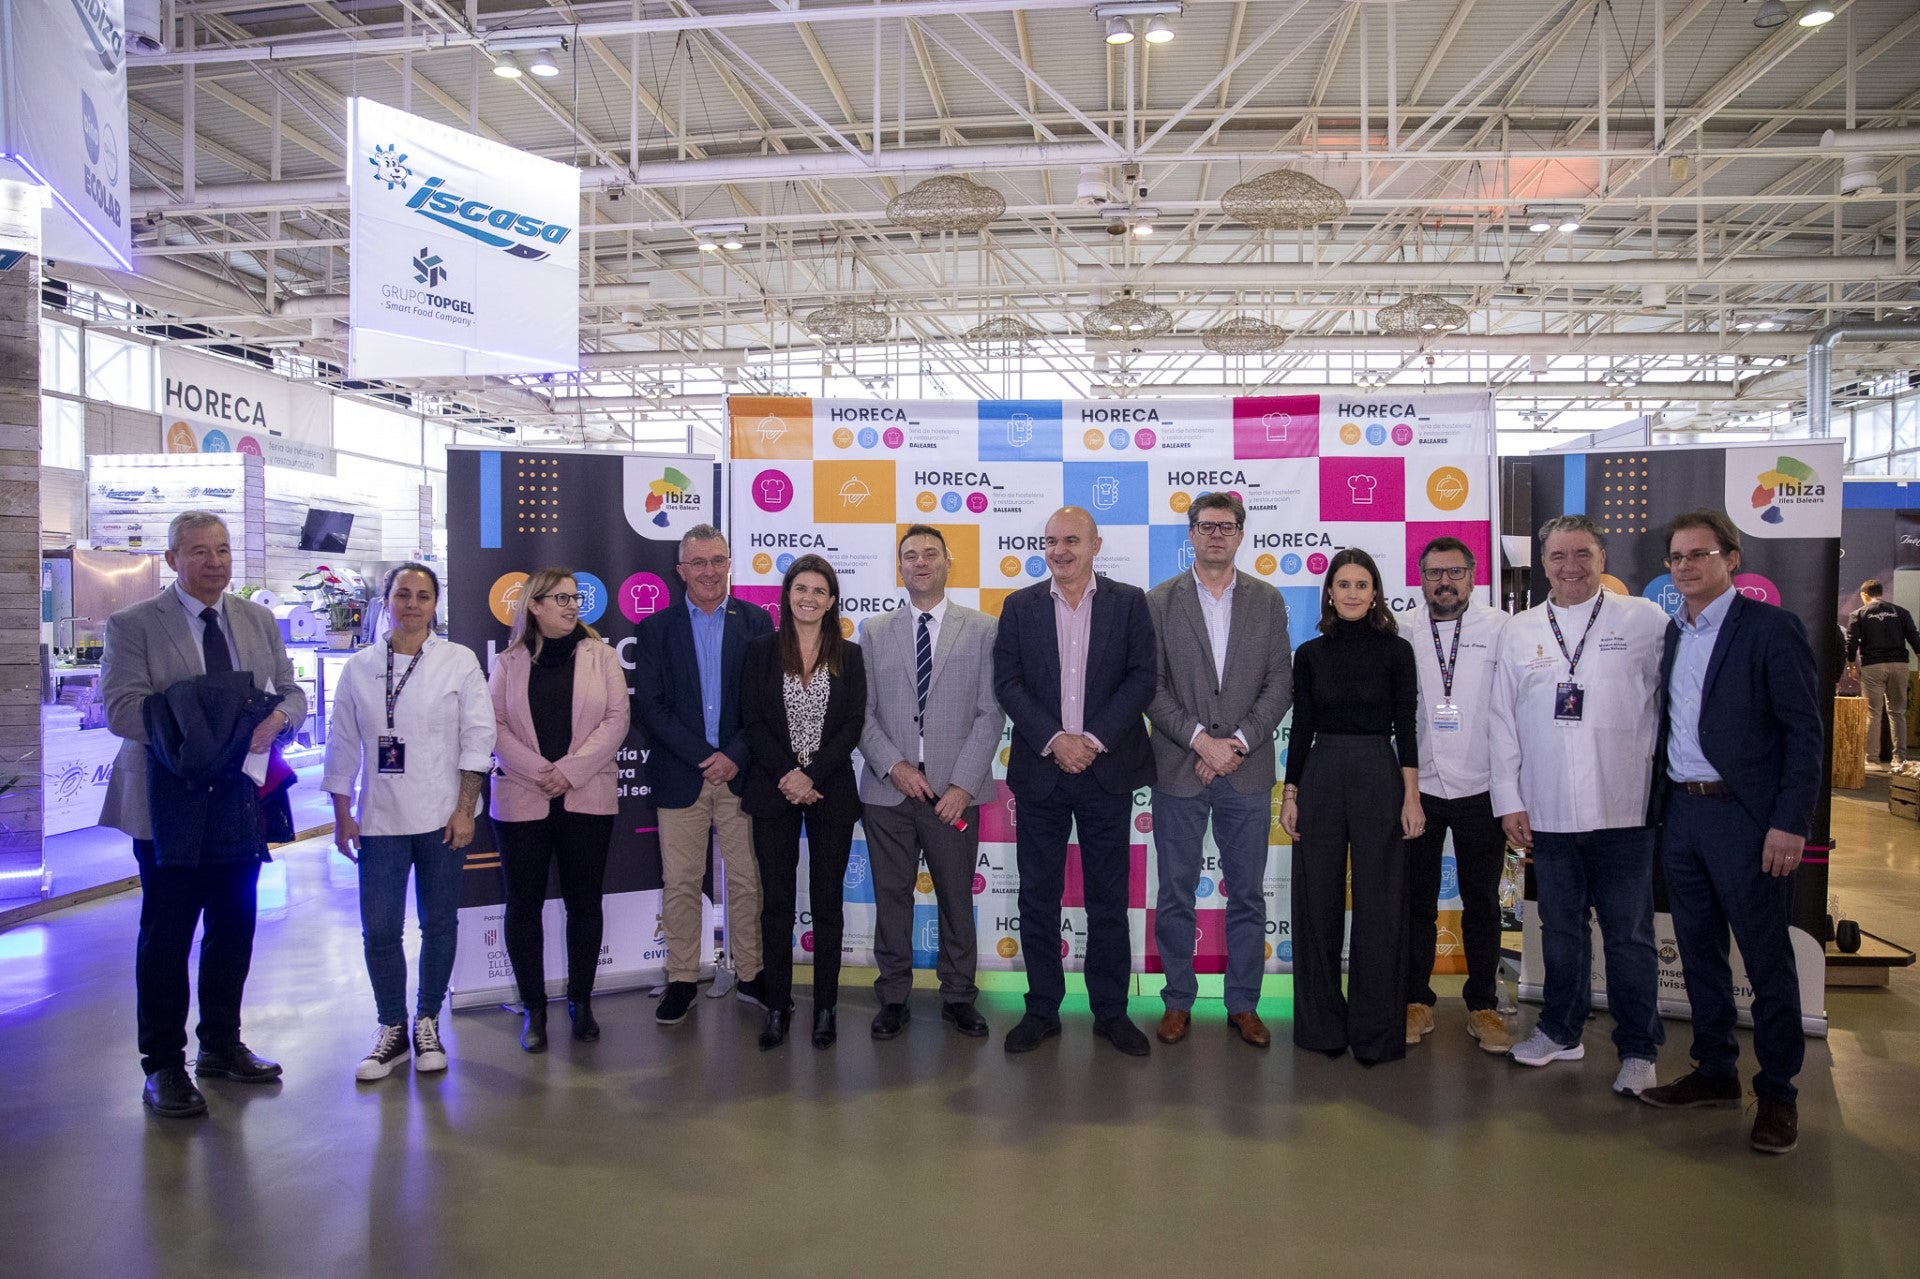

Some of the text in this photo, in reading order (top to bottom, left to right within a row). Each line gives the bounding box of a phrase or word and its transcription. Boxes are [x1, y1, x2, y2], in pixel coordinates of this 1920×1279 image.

[83, 163, 121, 228] ECOLAB
[385, 300, 472, 327] Smart Food Company
[1778, 482, 1825, 496] Ibiza
[666, 491, 701, 504] Ibiza
[641, 749, 651, 763] y
